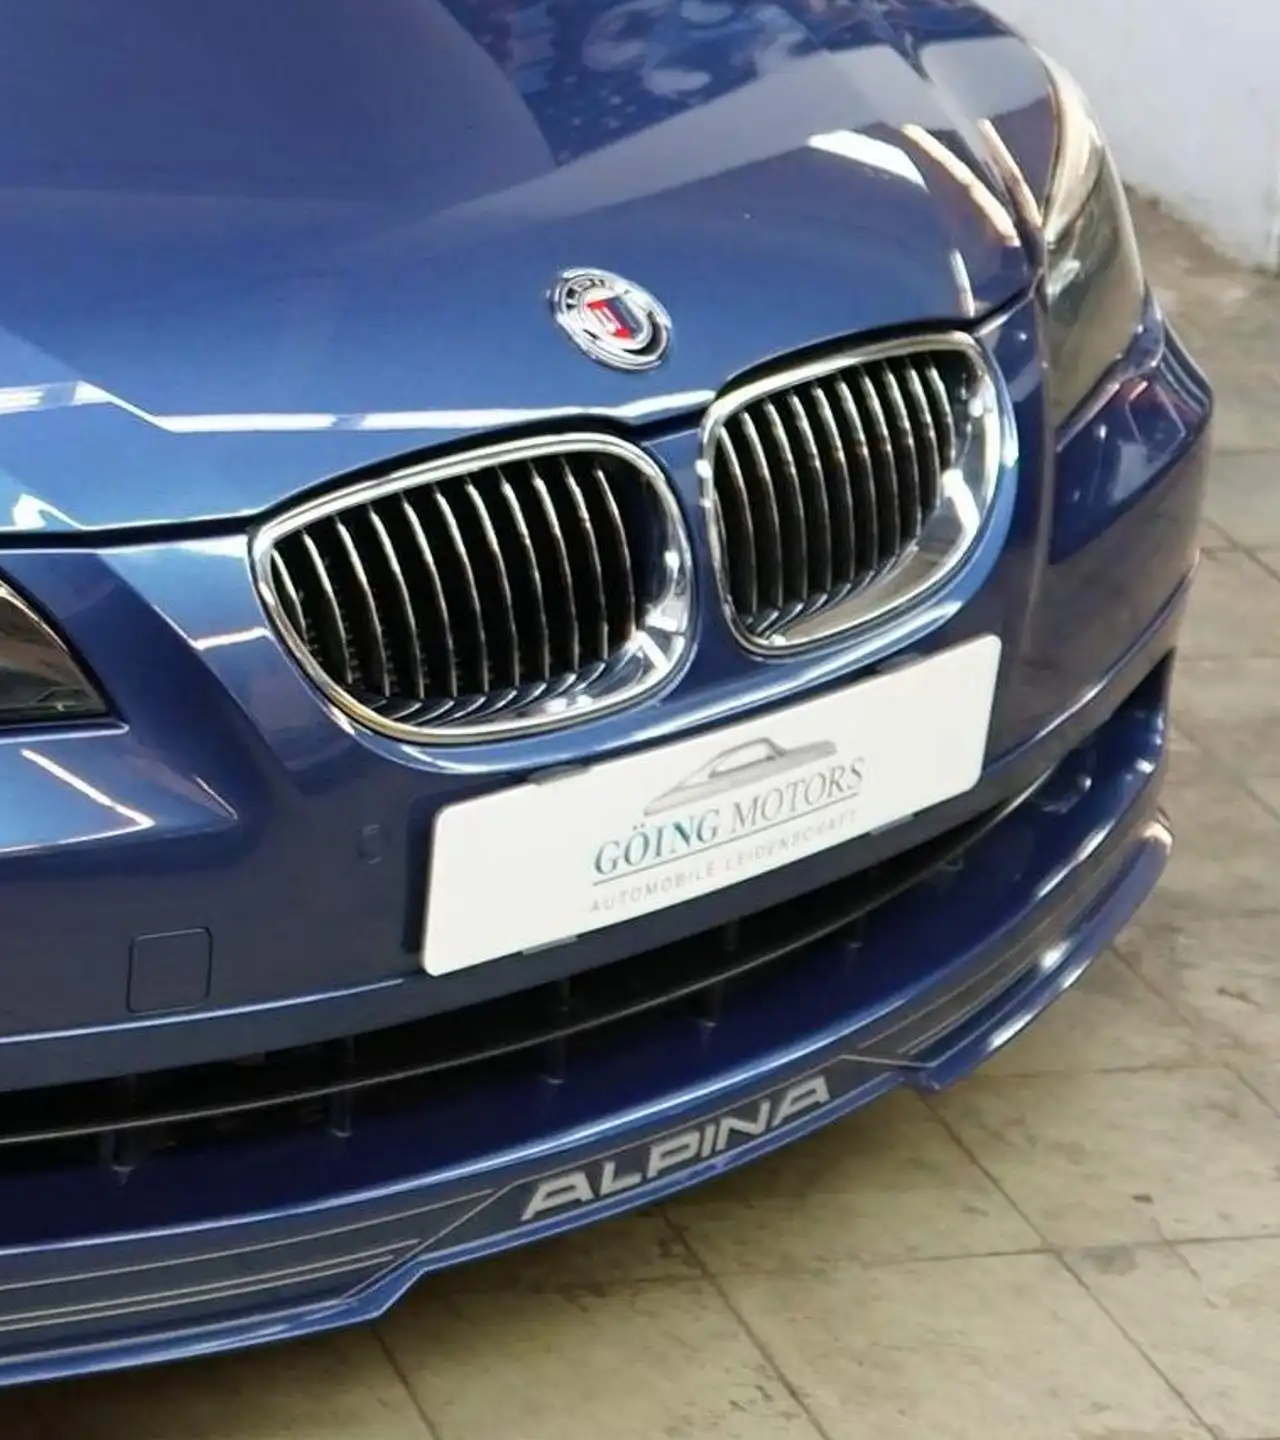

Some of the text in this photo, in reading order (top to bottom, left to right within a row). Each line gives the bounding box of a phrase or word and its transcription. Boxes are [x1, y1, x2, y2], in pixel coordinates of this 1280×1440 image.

[593, 757, 865, 876] GÖING MOTORS
[591, 861, 715, 913] AUTOMOBILE
[521, 1075, 830, 1222] ALPINA
